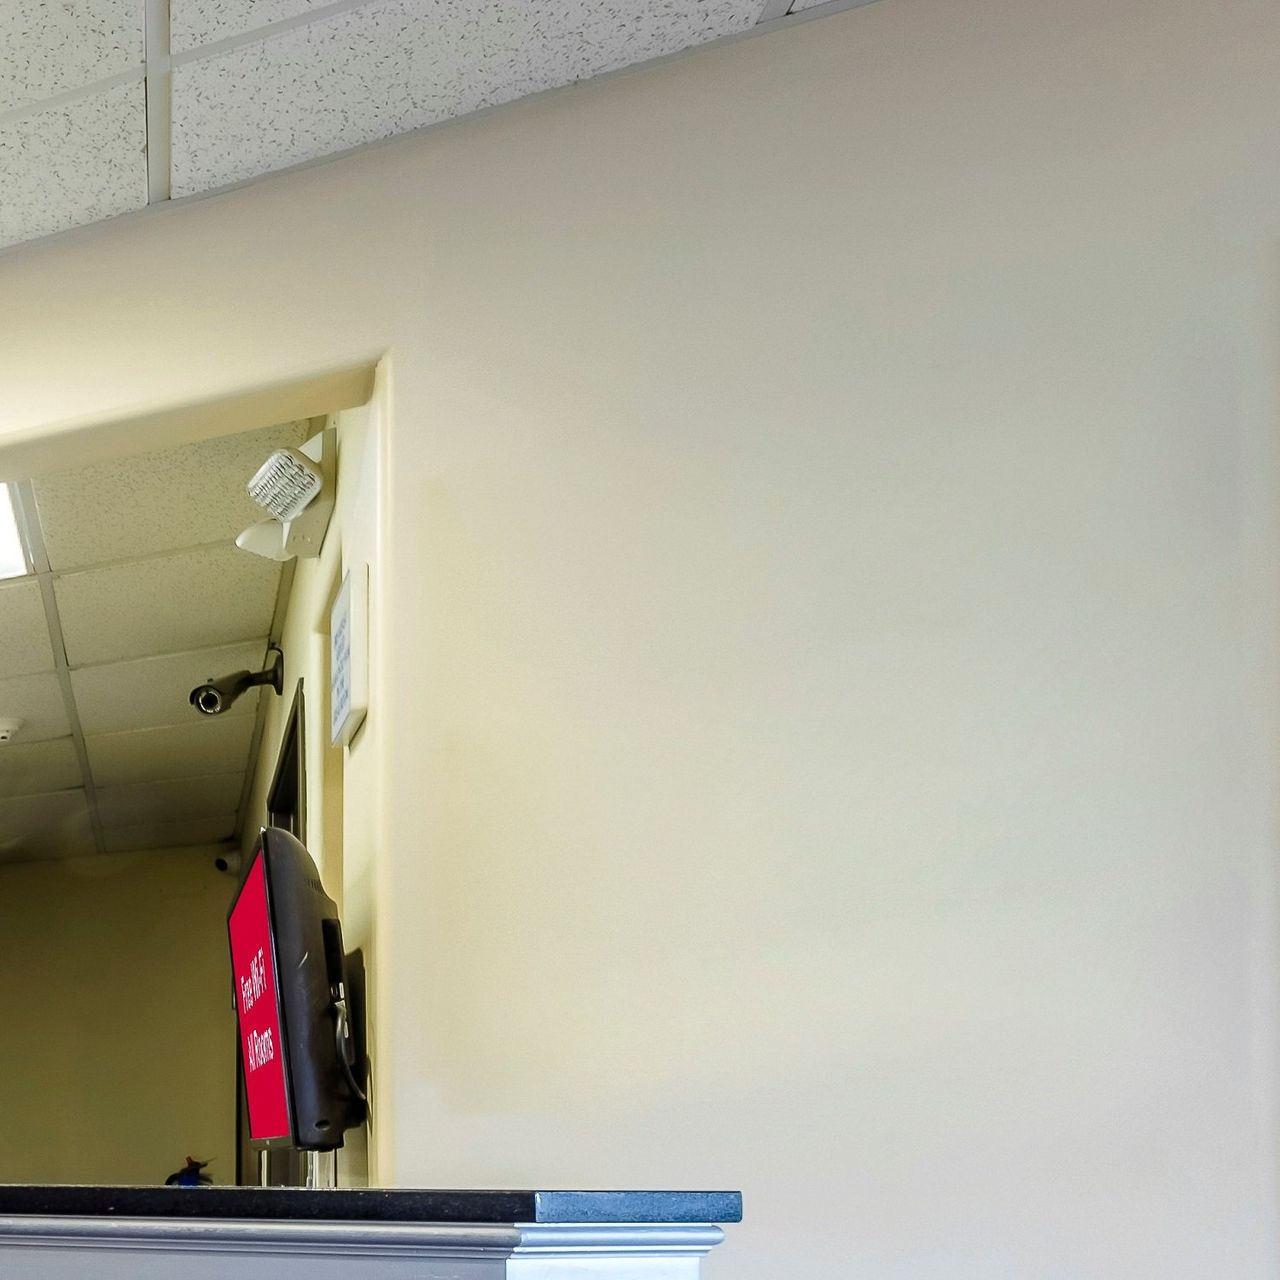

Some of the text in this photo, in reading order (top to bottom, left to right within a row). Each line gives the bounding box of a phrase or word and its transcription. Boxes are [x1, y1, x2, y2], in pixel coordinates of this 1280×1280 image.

[240, 947, 267, 1014] Free Wi-Fi
[253, 1027, 274, 1069] Rooms
